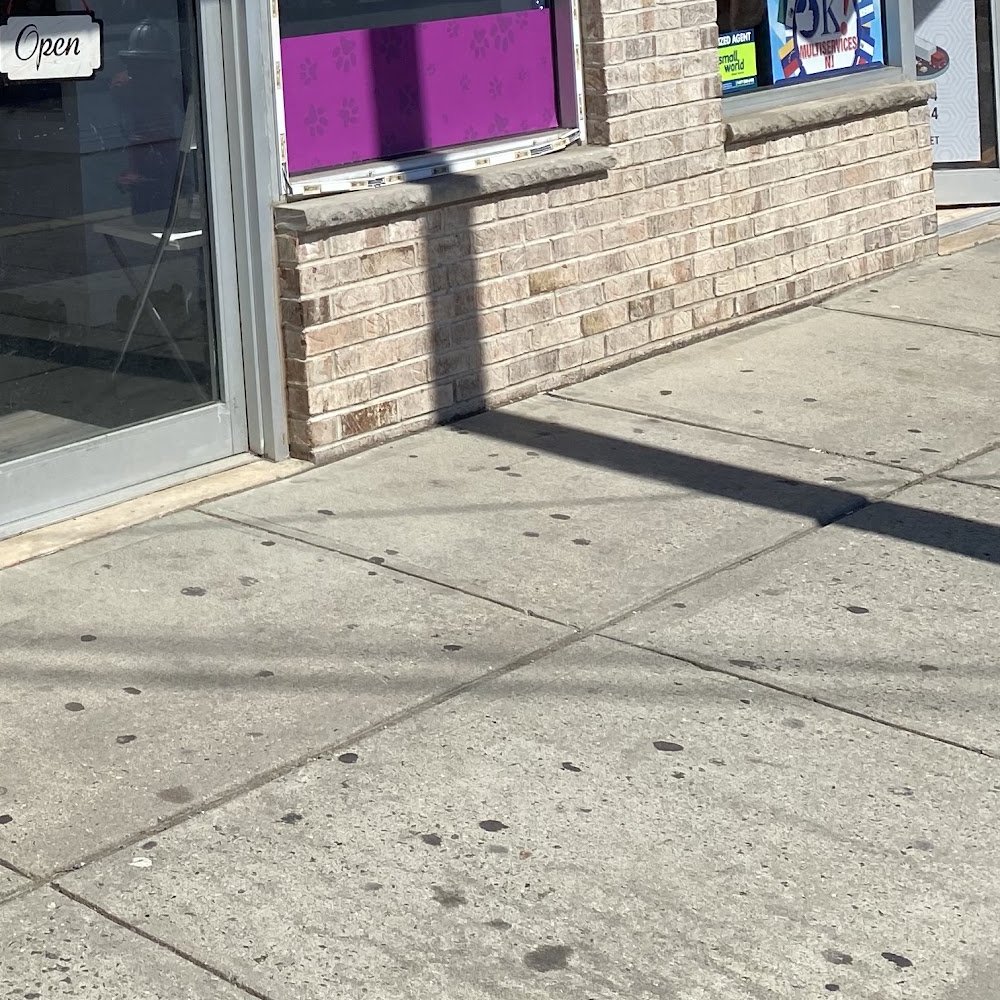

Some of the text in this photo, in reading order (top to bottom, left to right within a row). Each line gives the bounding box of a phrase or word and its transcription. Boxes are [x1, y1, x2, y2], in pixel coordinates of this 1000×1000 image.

[732, 31, 751, 44] AGENT
[14, 22, 81, 71] Open
[799, 36, 857, 58] MULTISERVICES
[719, 50, 737, 65] small
[824, 56, 834, 69] NJ
[724, 59, 744, 73] world
